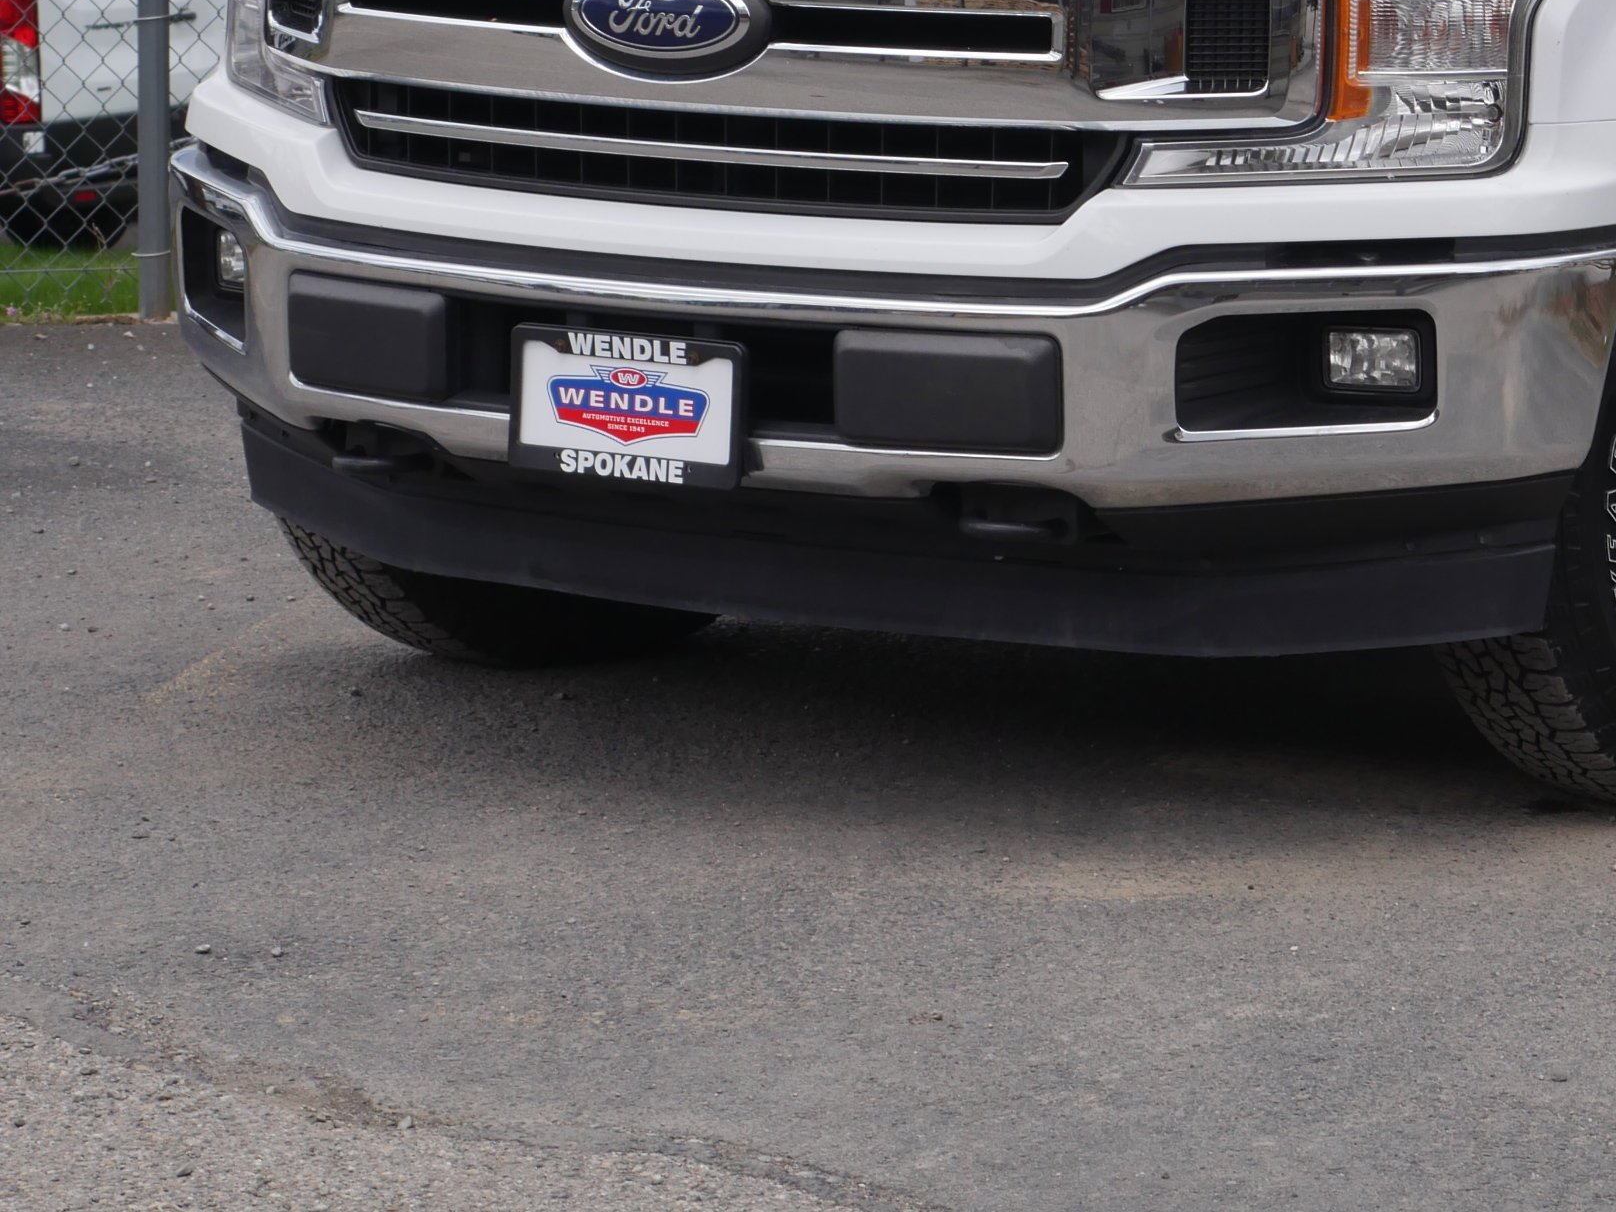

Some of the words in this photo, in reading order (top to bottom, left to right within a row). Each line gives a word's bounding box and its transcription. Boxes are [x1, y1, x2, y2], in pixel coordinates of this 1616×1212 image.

[568, 332, 687, 365] WENDLE
[558, 386, 695, 418] WENDLE
[582, 412, 626, 424] AUTOMOTIVE
[626, 417, 670, 428] EXCELLENCE
[607, 423, 628, 432] SINCE
[629, 425, 645, 433] 1943
[560, 448, 684, 484] SPOKANE
